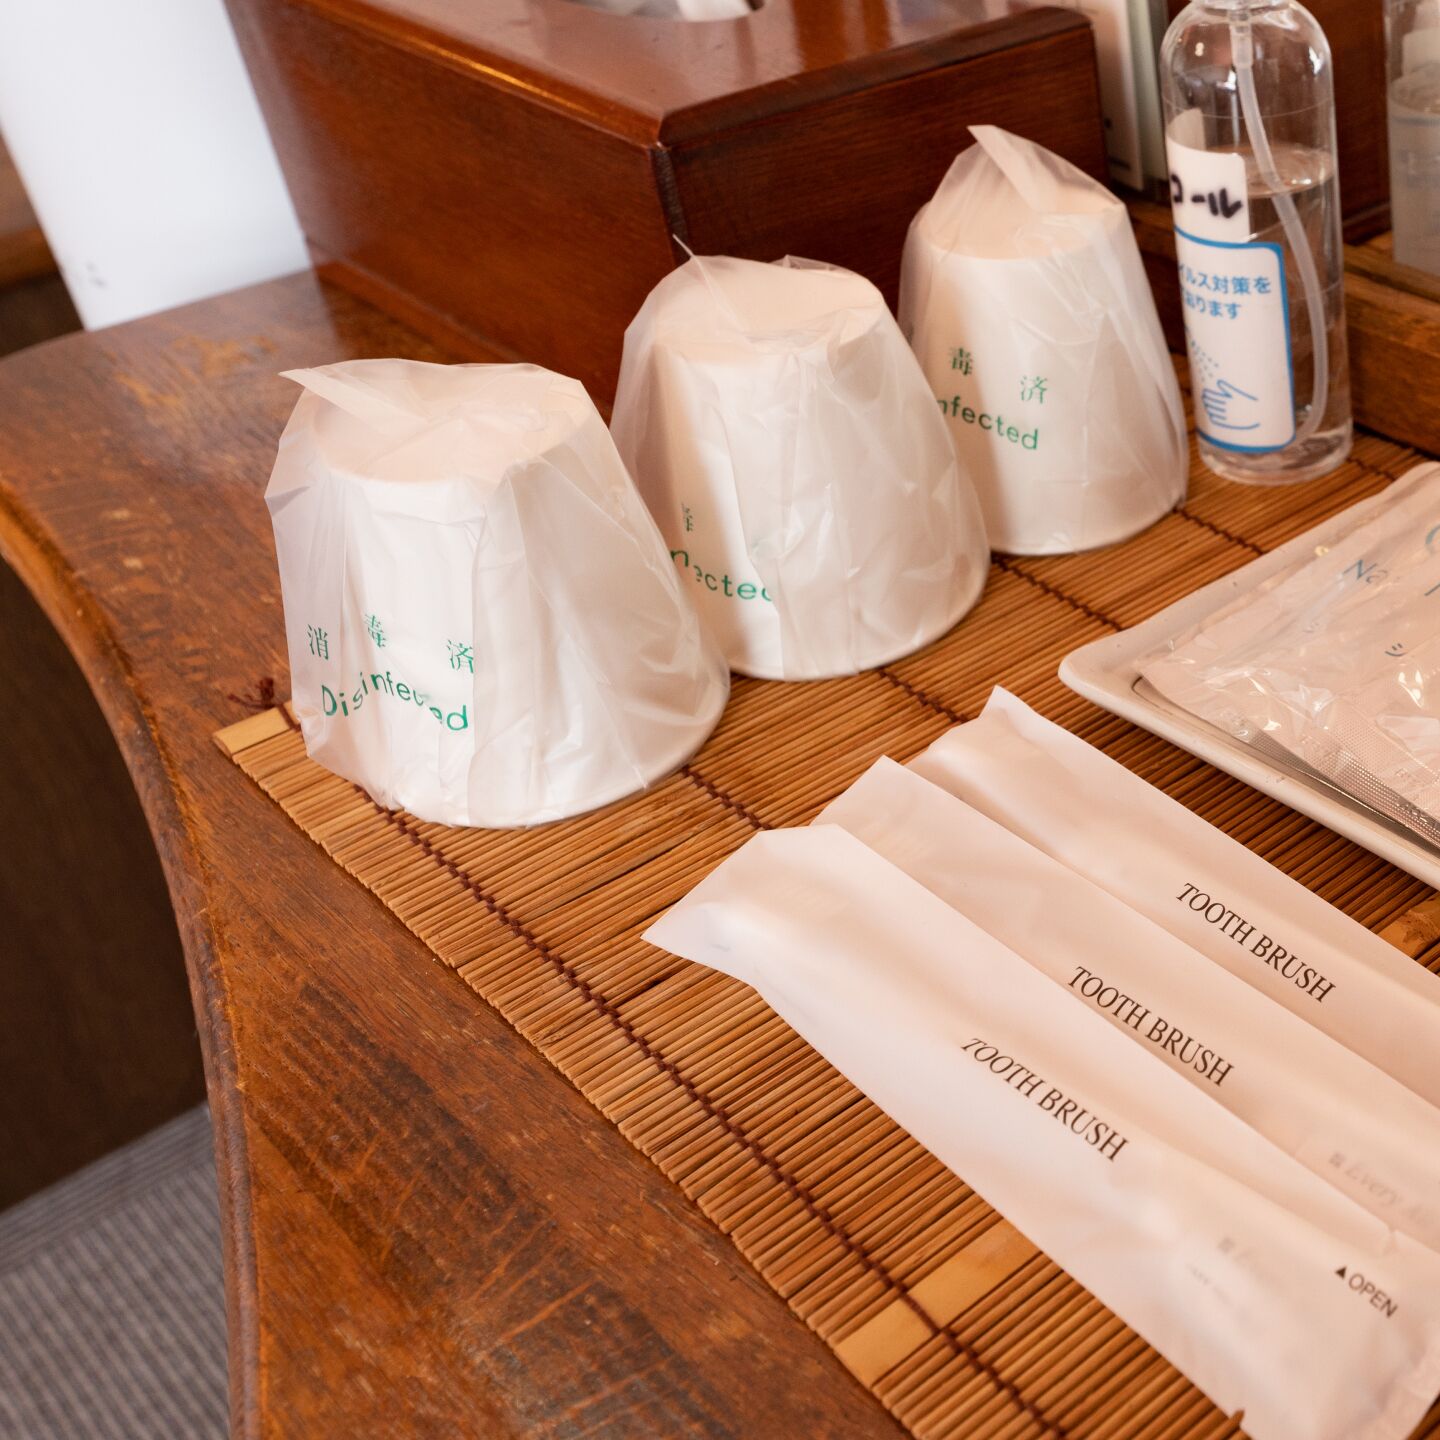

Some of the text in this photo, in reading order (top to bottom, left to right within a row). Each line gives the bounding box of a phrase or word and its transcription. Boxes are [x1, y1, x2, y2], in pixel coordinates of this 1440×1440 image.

[937, 395, 1038, 450] nfected
[1175, 882, 1337, 1004] TOOTH BRUSH
[1067, 965, 1235, 1088] TOOTH BRUSH
[959, 1037, 1130, 1163] TOOTH BRUSH
[1348, 1272, 1400, 1320] OPEN
